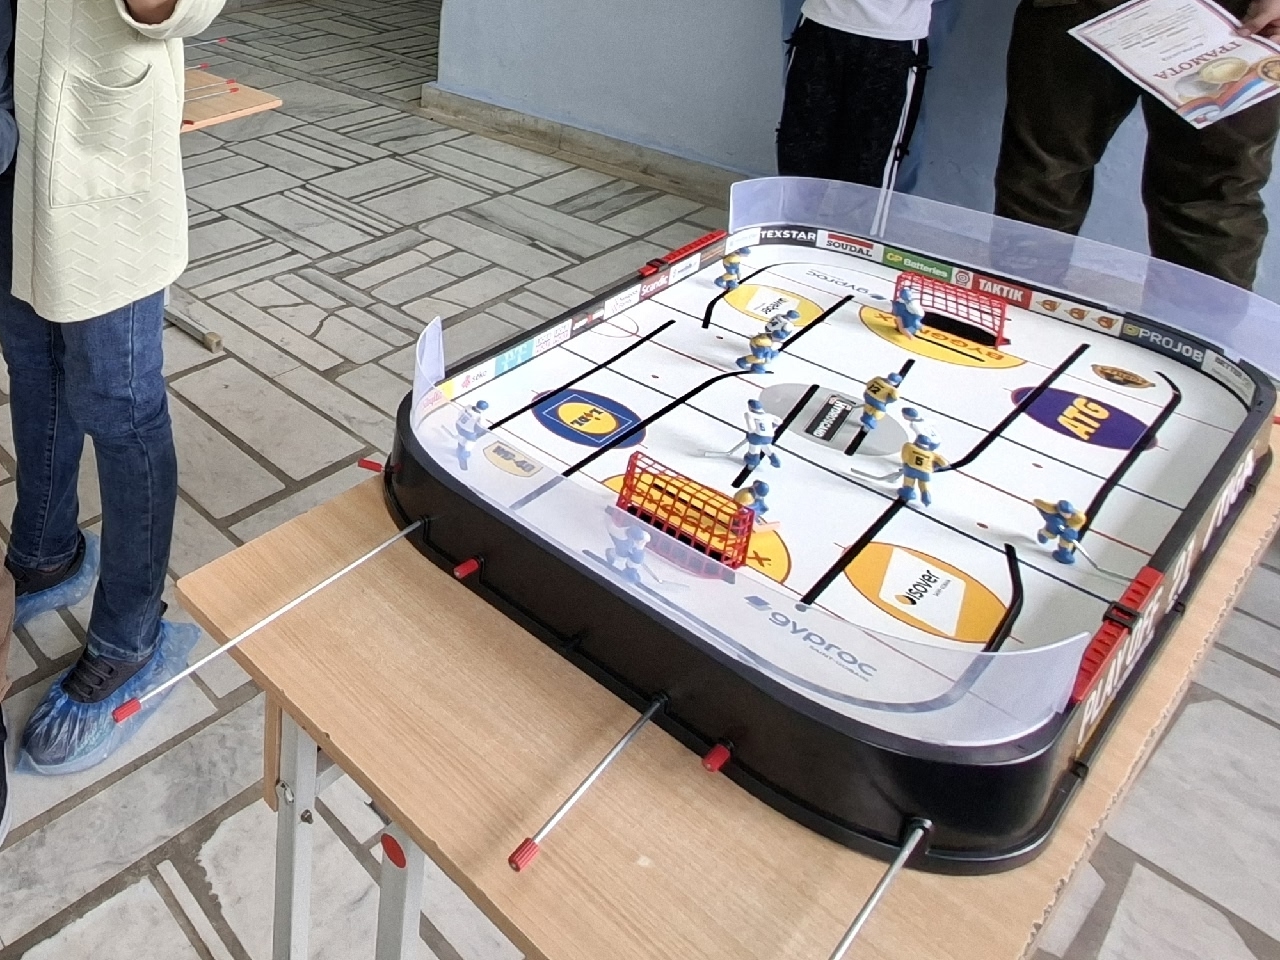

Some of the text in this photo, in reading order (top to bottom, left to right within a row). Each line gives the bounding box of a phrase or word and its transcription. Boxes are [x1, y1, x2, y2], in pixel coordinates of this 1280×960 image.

[1153, 40, 1243, 80] ГРАМОТА
[760, 229, 816, 242] TEXSTAR
[826, 239, 873, 258] SOUDAL
[885, 252, 904, 263] GP
[903, 257, 949, 280] Batteries
[640, 274, 669, 297] Scandic
[978, 278, 1024, 302] TAKTIK
[1138, 327, 1204, 363] PROJOB
[1057, 396, 1110, 441] ATG
[492, 445, 536, 473] WD-40
[768, 611, 878, 678] gyproc
